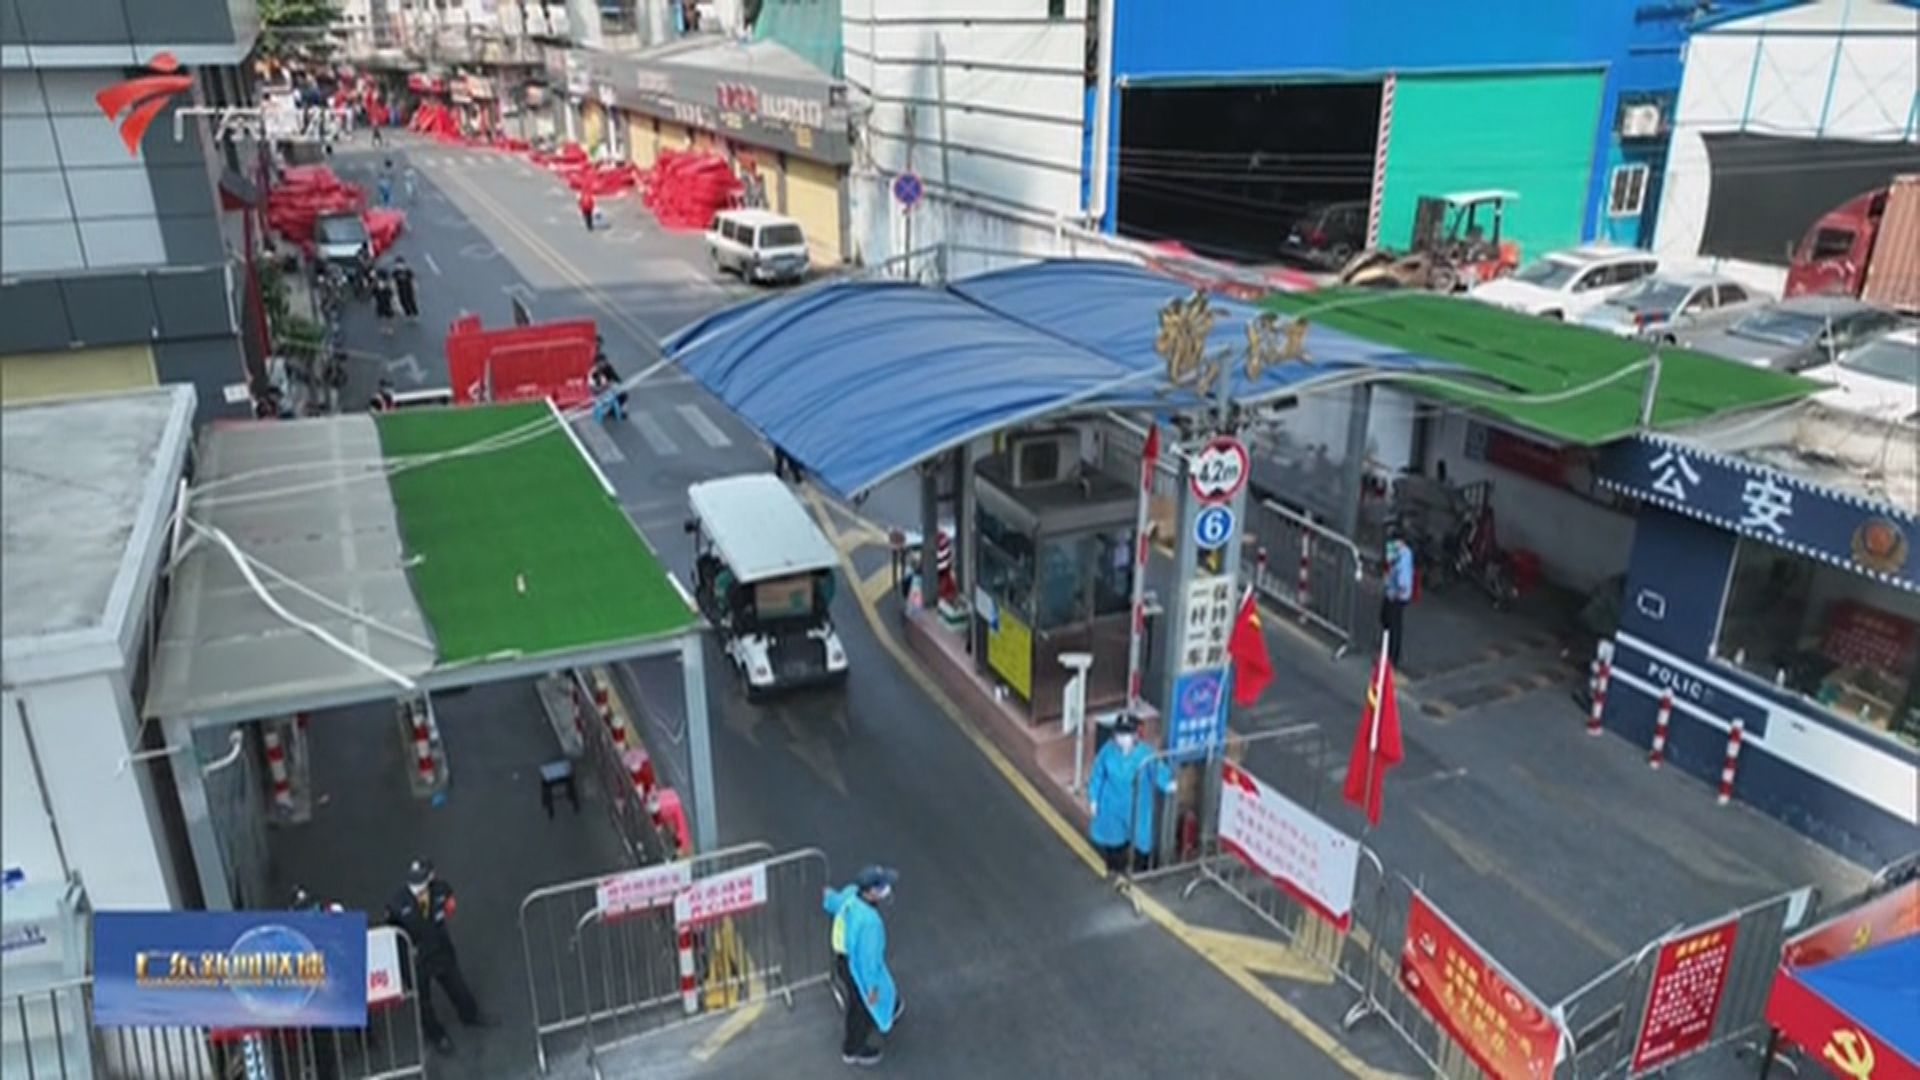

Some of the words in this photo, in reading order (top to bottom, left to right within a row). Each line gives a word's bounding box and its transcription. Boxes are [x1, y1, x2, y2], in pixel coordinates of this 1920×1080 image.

[1648, 450, 1793, 535] 公安
[1204, 510, 1223, 541] 6
[1206, 582, 1229, 664] 保持车距
[1647, 661, 1713, 703] POLIC
